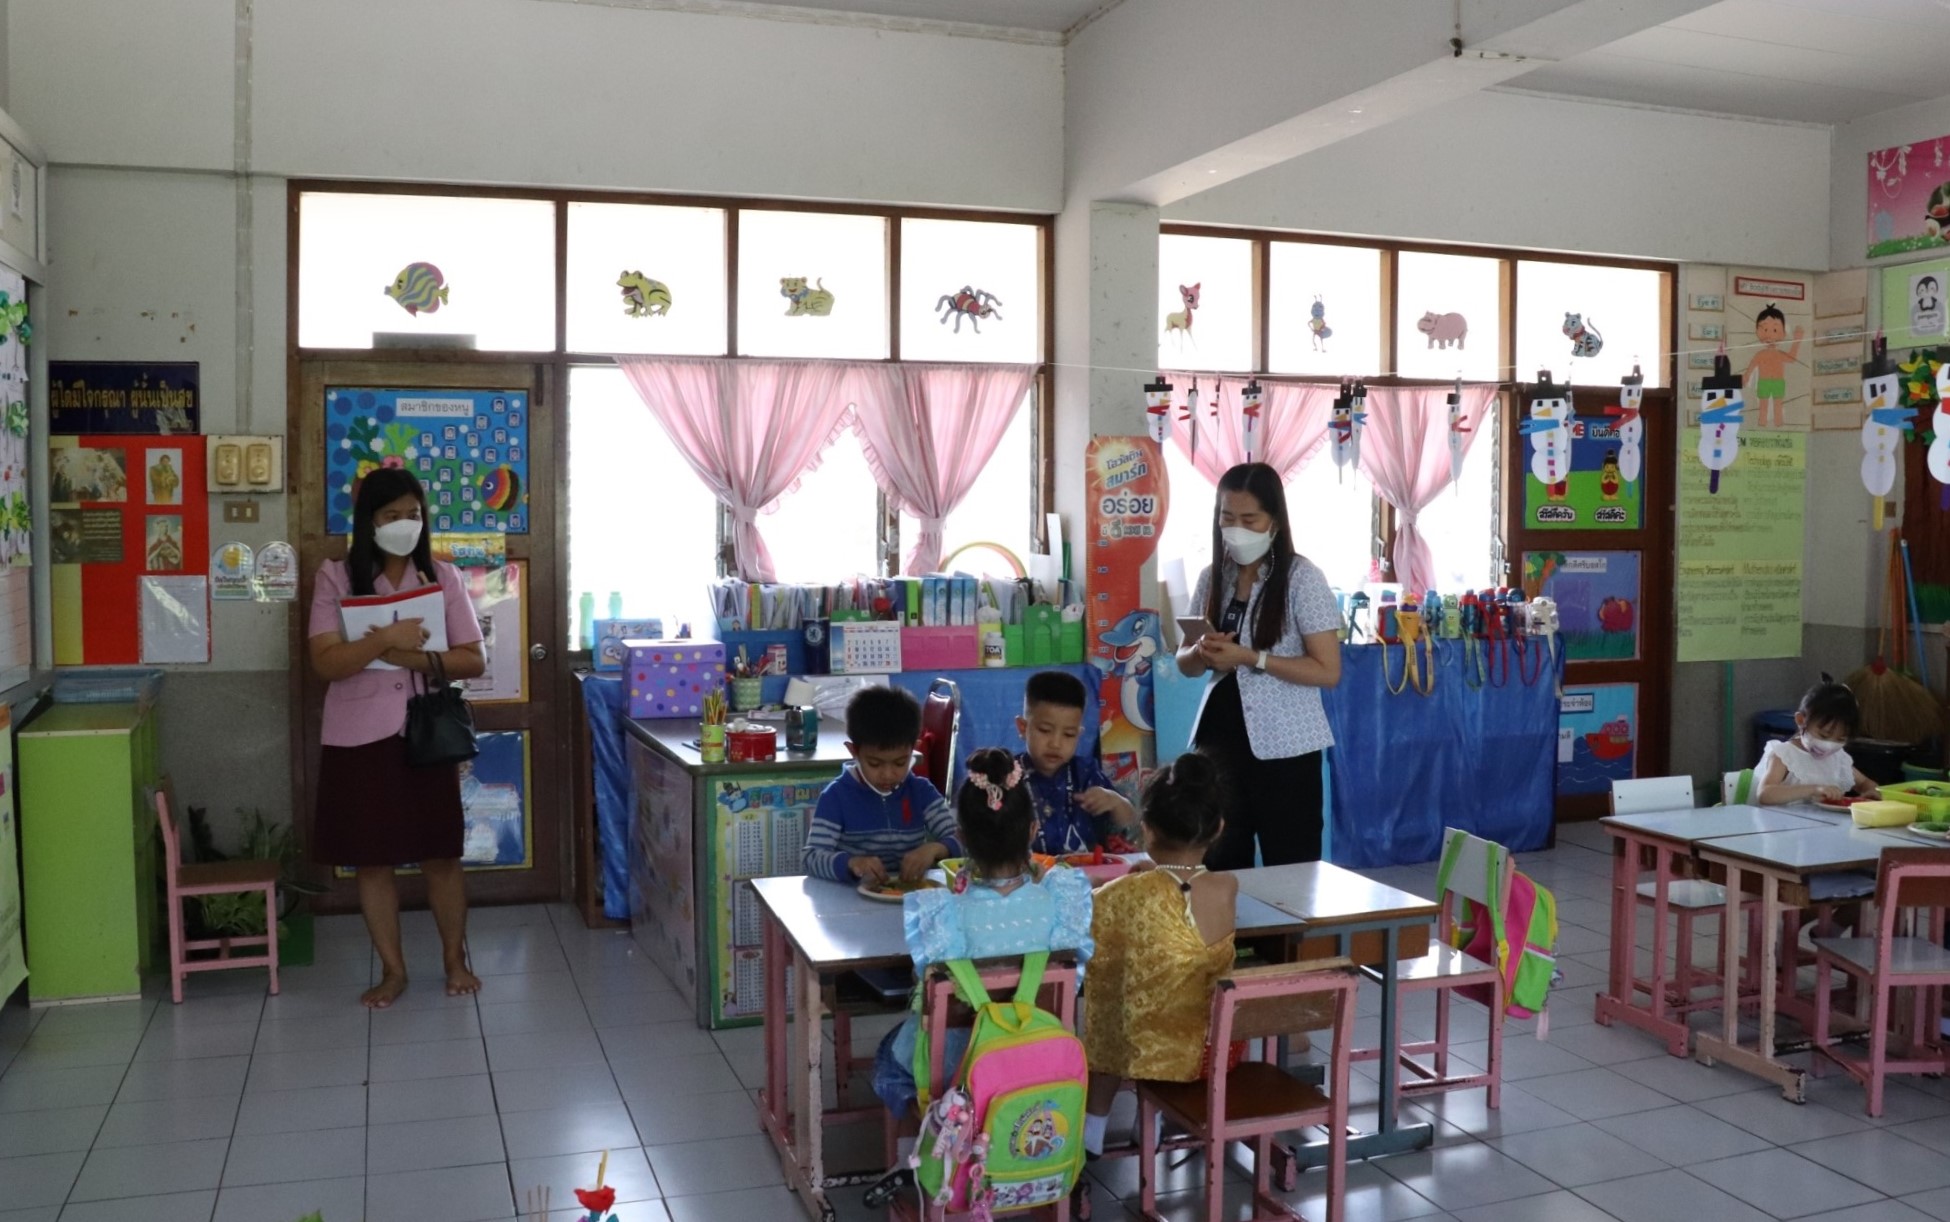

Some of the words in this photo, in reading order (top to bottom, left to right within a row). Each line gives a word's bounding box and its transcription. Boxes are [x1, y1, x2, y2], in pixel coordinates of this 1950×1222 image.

[51, 379, 126, 419] ผู้ใดมีใจกรุณา
[400, 400, 470, 417] สมาชิกของหนู
[1102, 490, 1154, 515] อร่อย
